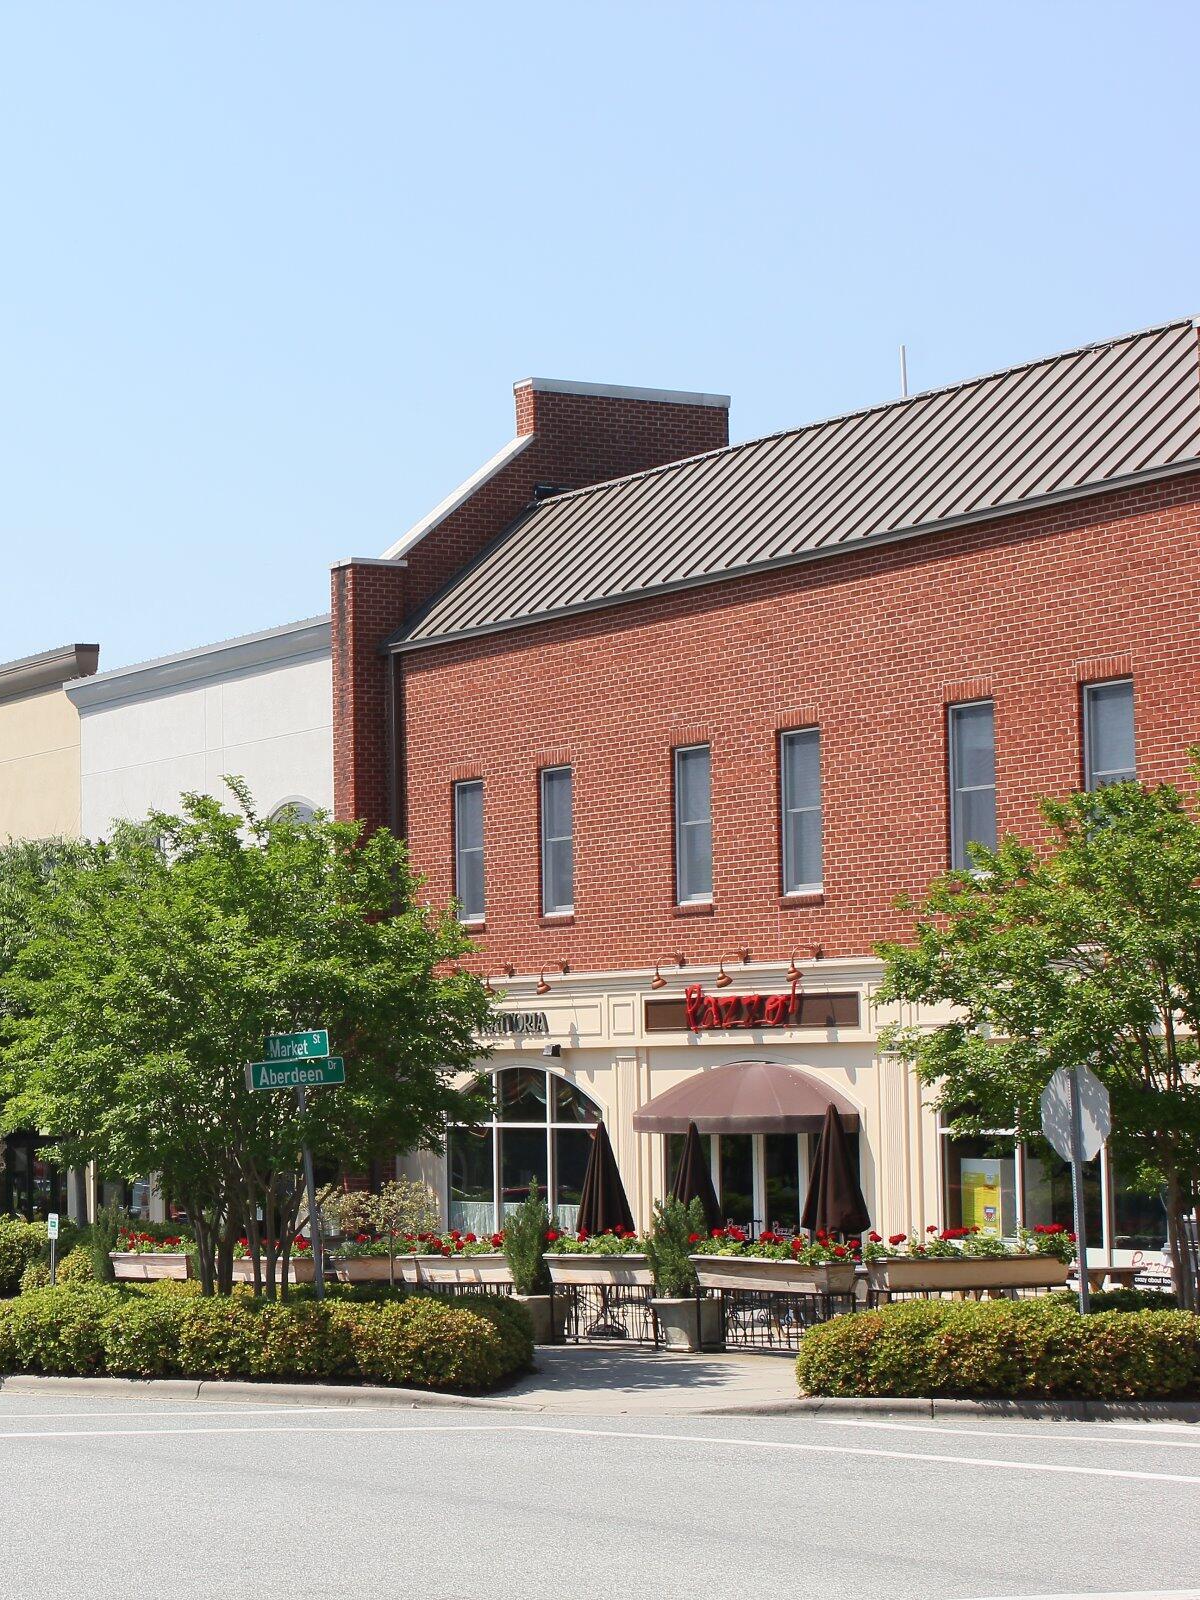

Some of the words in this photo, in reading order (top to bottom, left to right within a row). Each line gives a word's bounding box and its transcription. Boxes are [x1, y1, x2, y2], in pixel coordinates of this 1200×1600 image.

[270, 1038, 309, 1058] Market
[312, 1033, 321, 1044] St
[259, 1066, 324, 1086] Aberdeen
[327, 1060, 337, 1070] Dr
[1134, 1276, 1148, 1284] crazy
[1147, 1276, 1162, 1284] about
